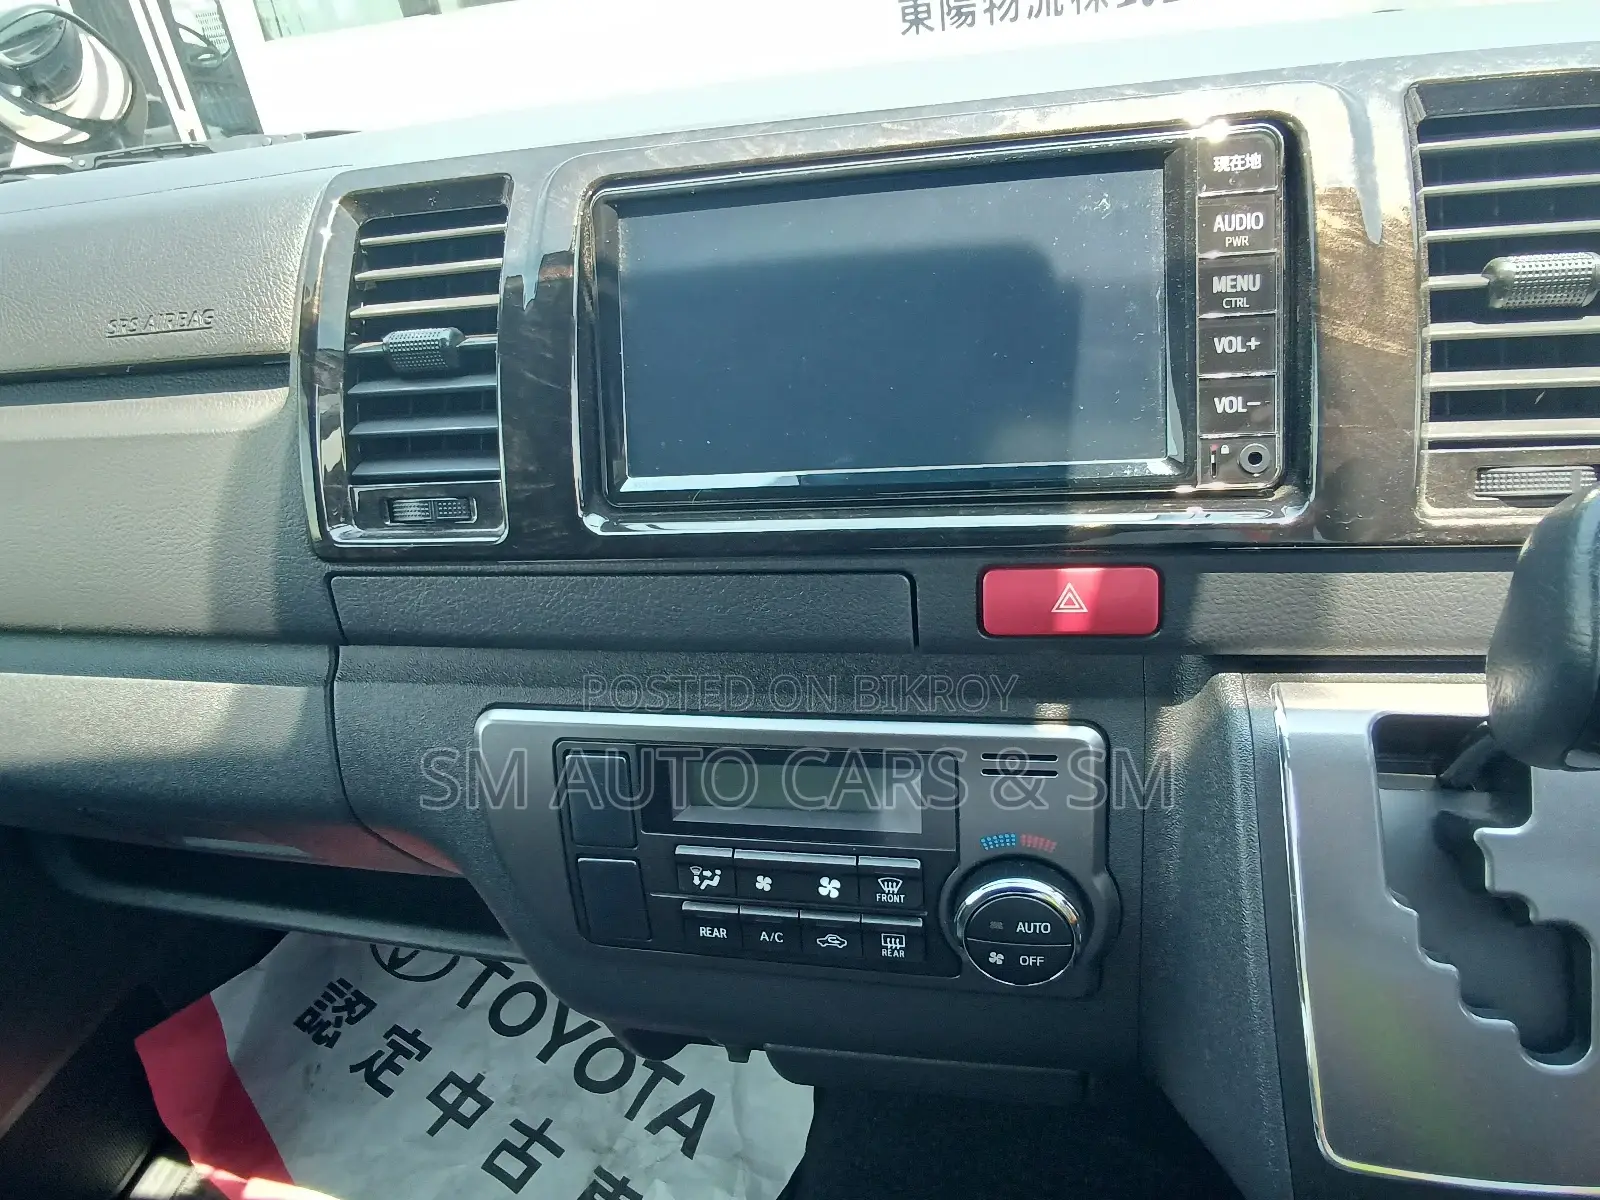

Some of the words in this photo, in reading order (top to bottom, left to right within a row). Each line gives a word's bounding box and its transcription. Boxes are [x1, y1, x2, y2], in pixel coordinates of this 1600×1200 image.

[1213, 152, 1262, 173] 現在地
[1213, 211, 1264, 233] AUDIO
[1225, 235, 1249, 247] PWR
[1212, 273, 1261, 294] MENU
[1222, 297, 1250, 309] CTRL
[143, 308, 215, 331] AIRBAG
[876, 893, 905, 903] FRONT
[699, 926, 728, 939] REAR
[1016, 921, 1051, 934] AUTO
[759, 931, 784, 943] A/C
[881, 949, 905, 958] REAR
[1019, 955, 1045, 967] OFF
[456, 957, 716, 1160] TOYOTA
